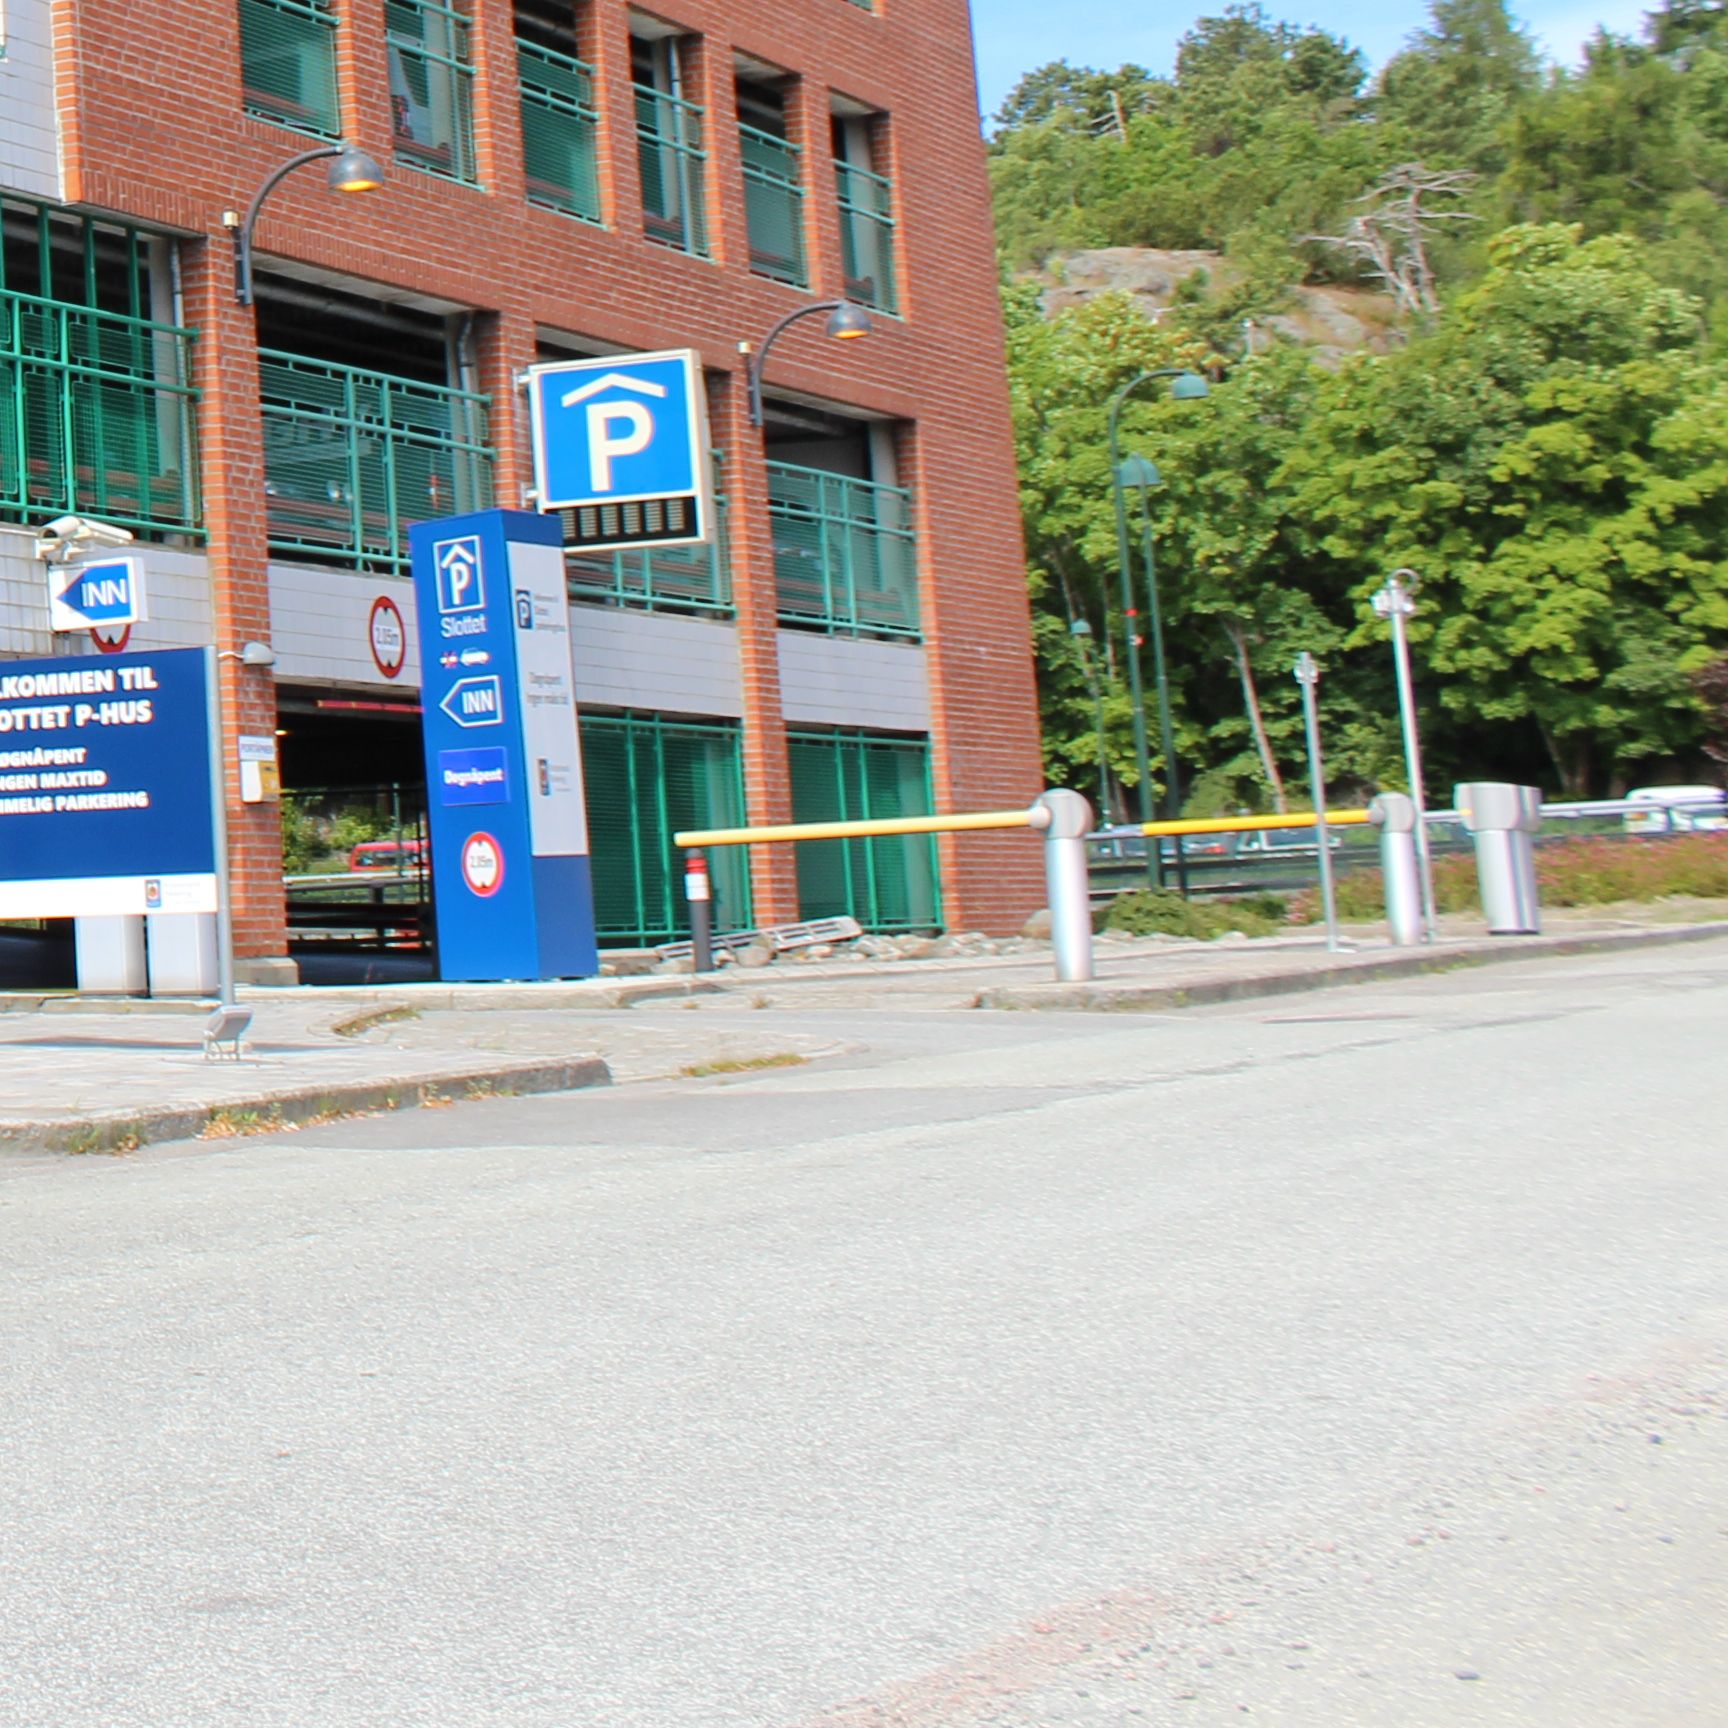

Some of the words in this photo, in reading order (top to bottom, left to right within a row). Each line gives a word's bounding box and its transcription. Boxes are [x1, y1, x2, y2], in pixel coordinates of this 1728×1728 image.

[586, 400, 655, 492] P
[81, 578, 128, 607] INN
[450, 562, 471, 605] P
[441, 614, 487, 638] Slottet
[118, 666, 159, 690] TIL
[75, 700, 153, 727] P-HUS
[462, 689, 496, 714] INN
[40, 770, 108, 789] MAXTID
[55, 791, 150, 812] PARKERING
